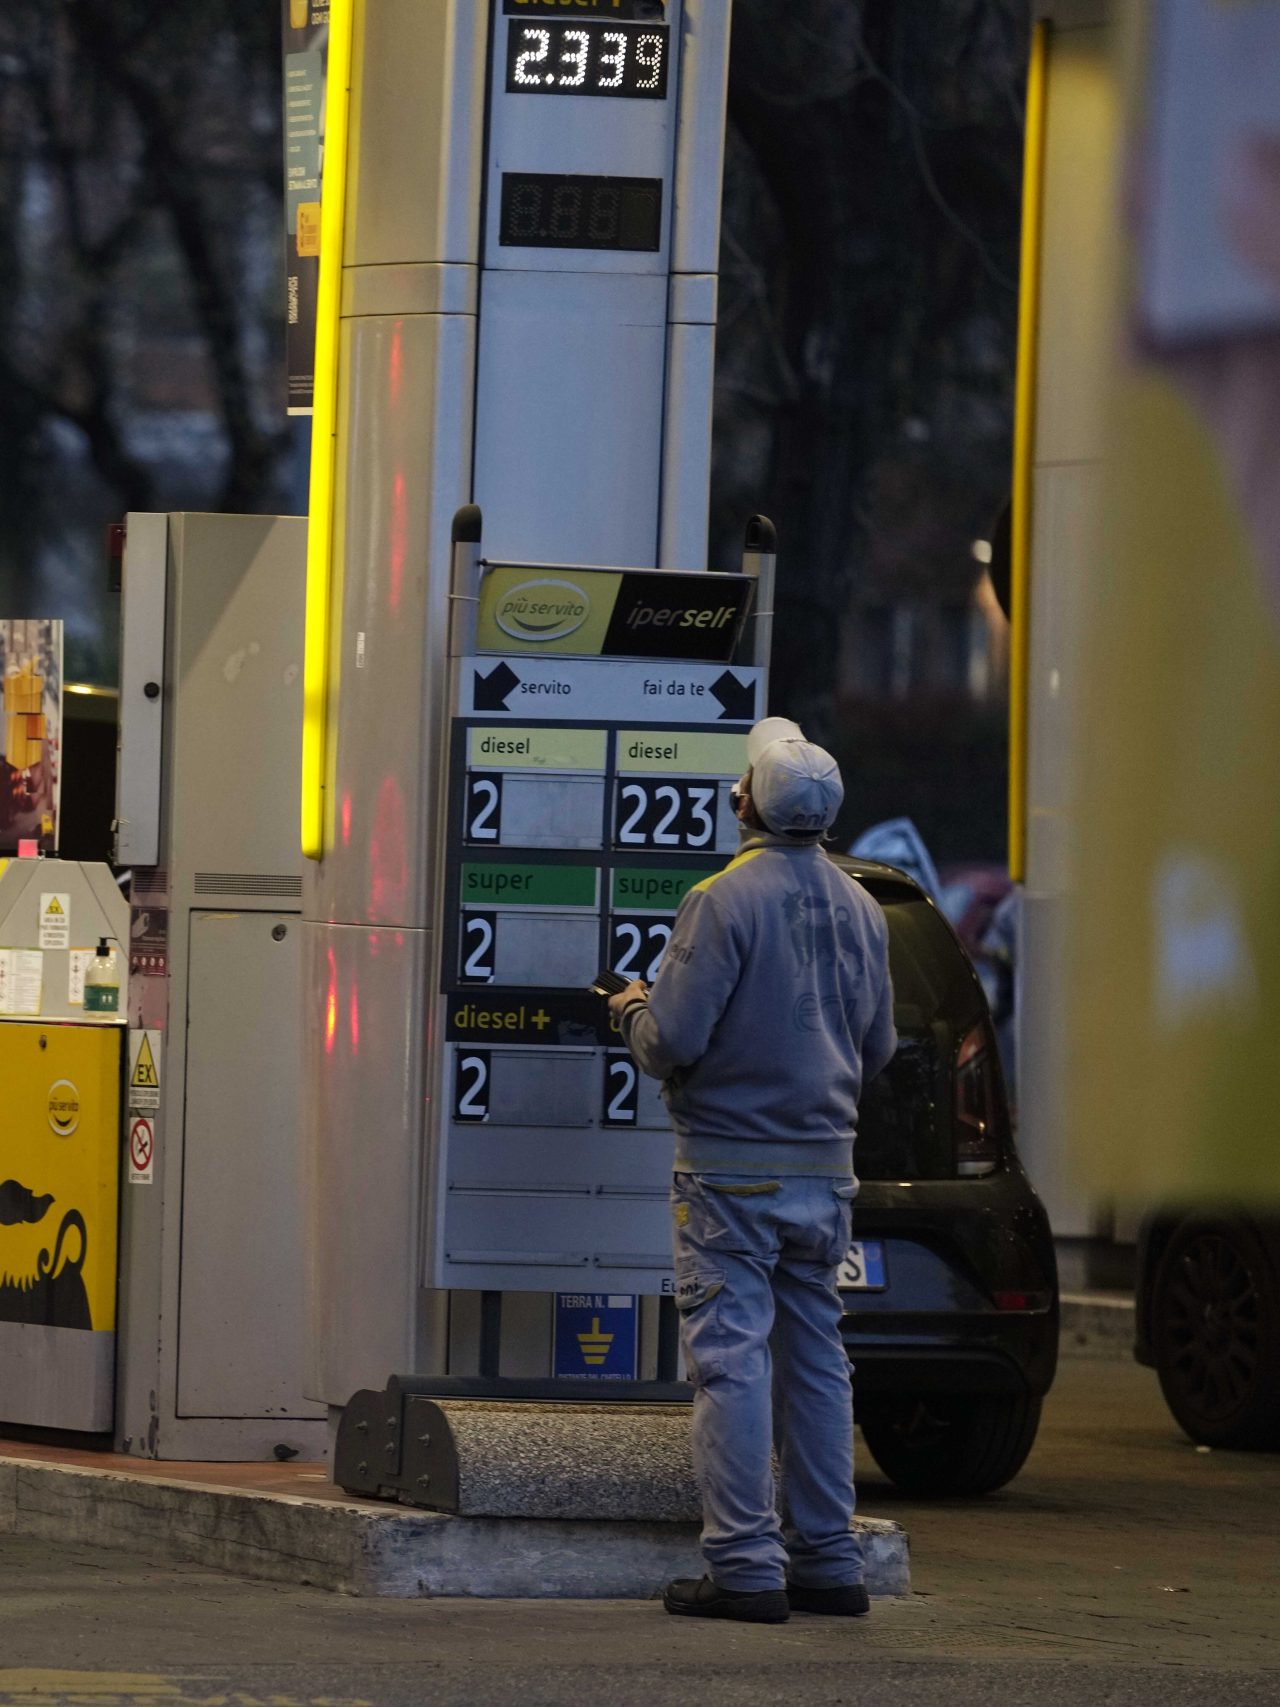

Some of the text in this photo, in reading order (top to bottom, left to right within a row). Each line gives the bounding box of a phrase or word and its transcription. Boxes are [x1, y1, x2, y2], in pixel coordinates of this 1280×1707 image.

[514, 29, 663, 88] 2.339
[501, 598, 584, 616] più servito
[626, 601, 736, 629] iperself
[521, 680, 571, 695] servito
[644, 680, 705, 695] fai da te
[481, 737, 530, 754] diesel
[629, 742, 678, 759] diesel
[470, 780, 499, 839] 2
[620, 784, 715, 847] 223
[791, 807, 828, 826] eni
[468, 871, 533, 894] super
[619, 876, 684, 899] super
[464, 918, 493, 977] 2
[454, 1004, 526, 1030] diesel
[138, 1064, 152, 1083] EX
[458, 1056, 488, 1117] 2
[607, 1061, 636, 1120] 2
[561, 1295, 605, 1308] TERRA N.
